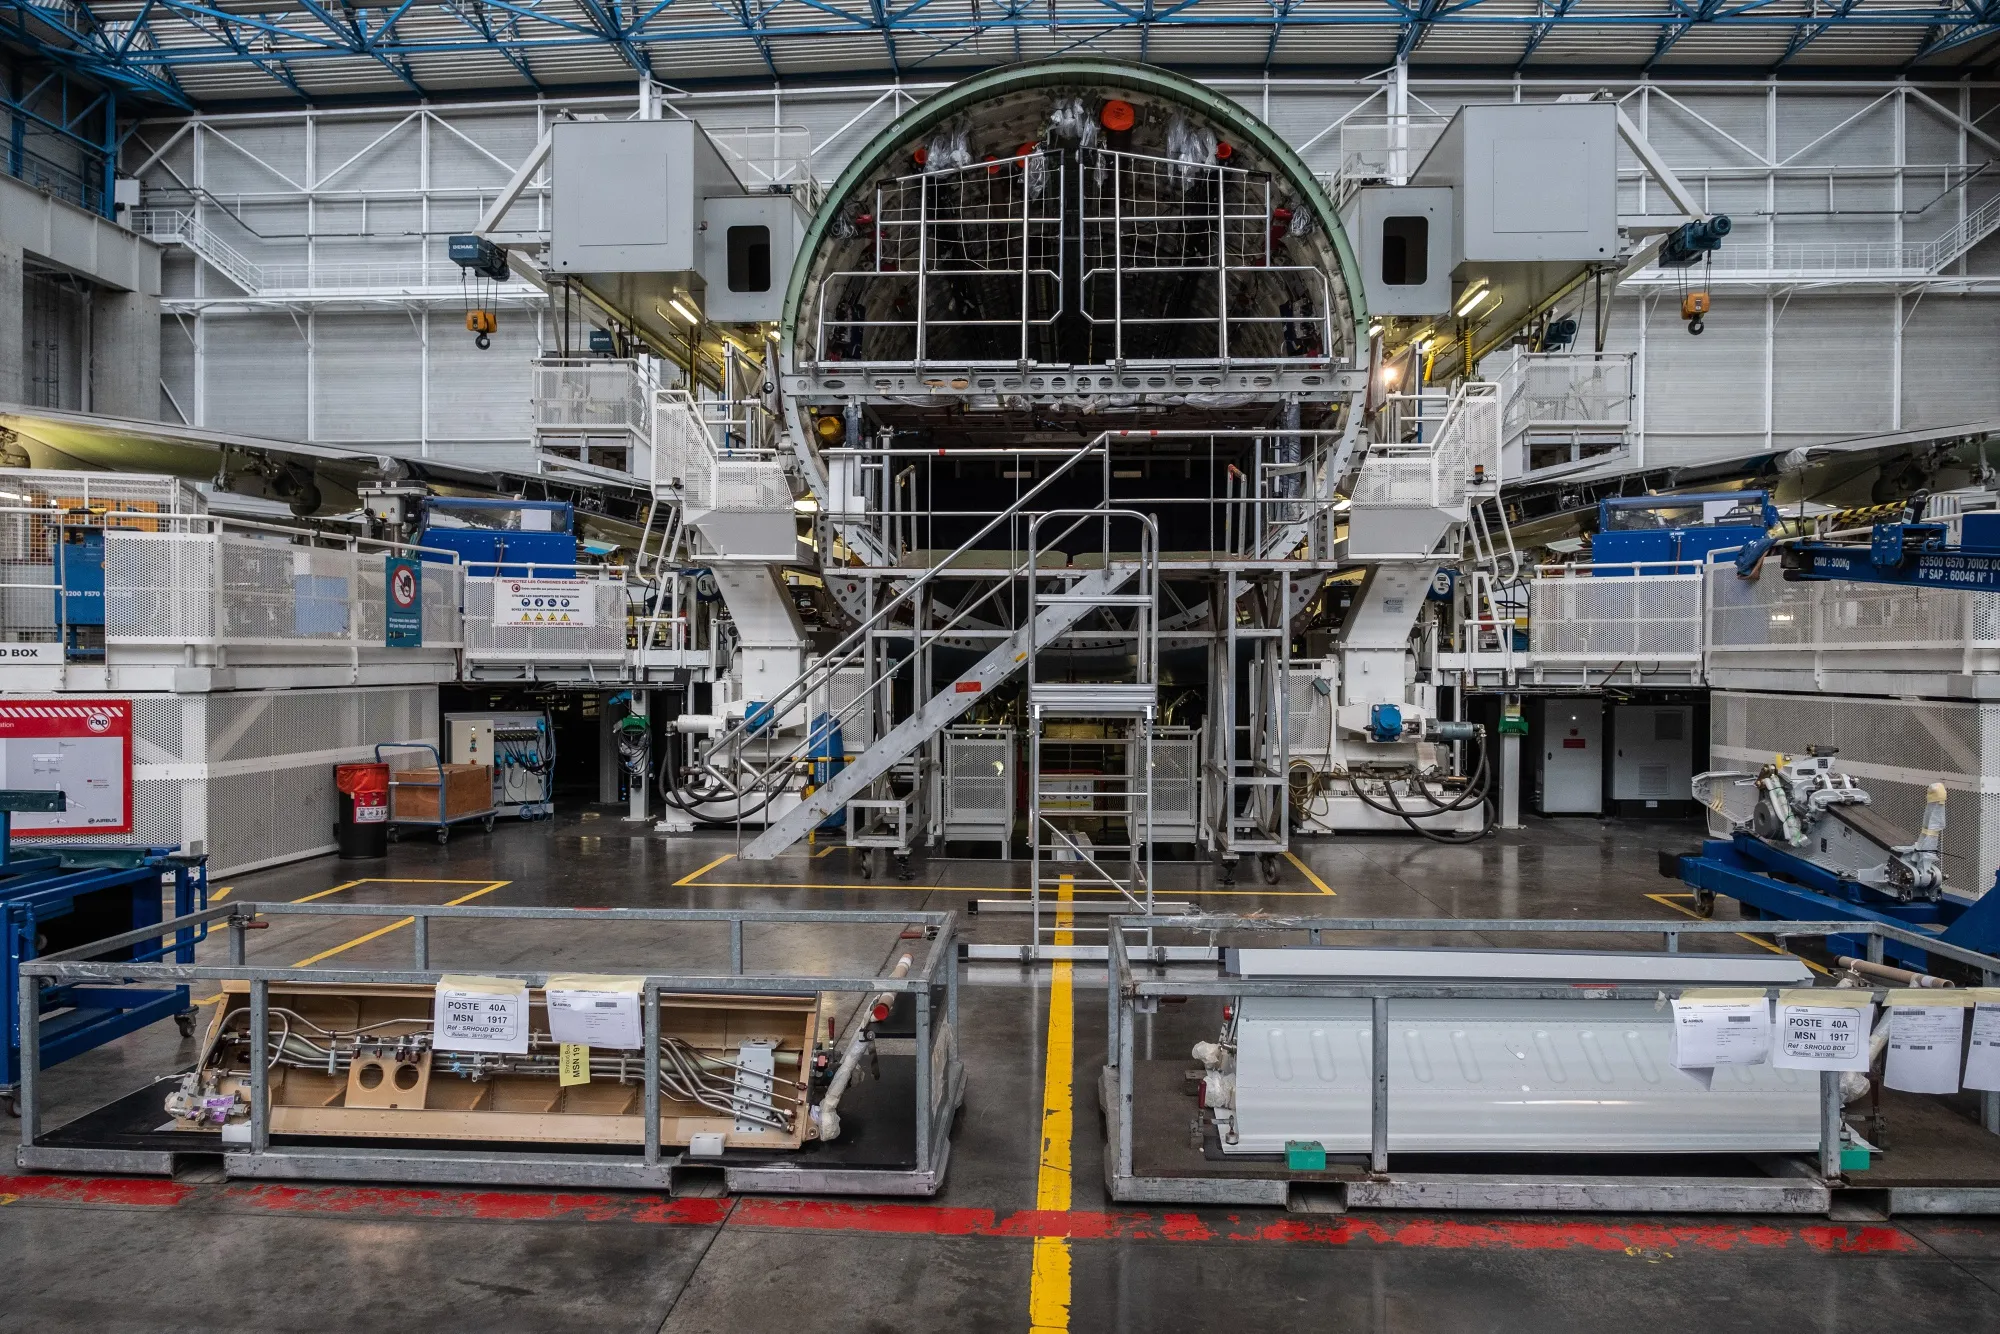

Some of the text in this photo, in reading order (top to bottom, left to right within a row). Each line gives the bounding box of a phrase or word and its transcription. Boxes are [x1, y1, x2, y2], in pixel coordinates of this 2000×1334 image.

[1813, 556, 1827, 567] CMU
[1831, 558, 1850, 571] 300Kg
[1919, 556, 1944, 567] 63500
[1945, 557, 1965, 568] G570
[1967, 558, 1989, 570] 70102
[1918, 568, 1928, 579] N°
[1928, 568, 1944, 580] SAP
[1949, 570, 1975, 583] 60046
[1976, 571, 1987, 583] N°
[1989, 572, 1994, 584] 1
[11, 649, 38, 657] BOX
[447, 1001, 507, 1012] POSTE 40A
[453, 1013, 508, 1024] MSN 1917
[1789, 1018, 1848, 1028] POSTE 40A
[1794, 1031, 1849, 1041] MSN 1917
[572, 1058, 580, 1078] MSN
